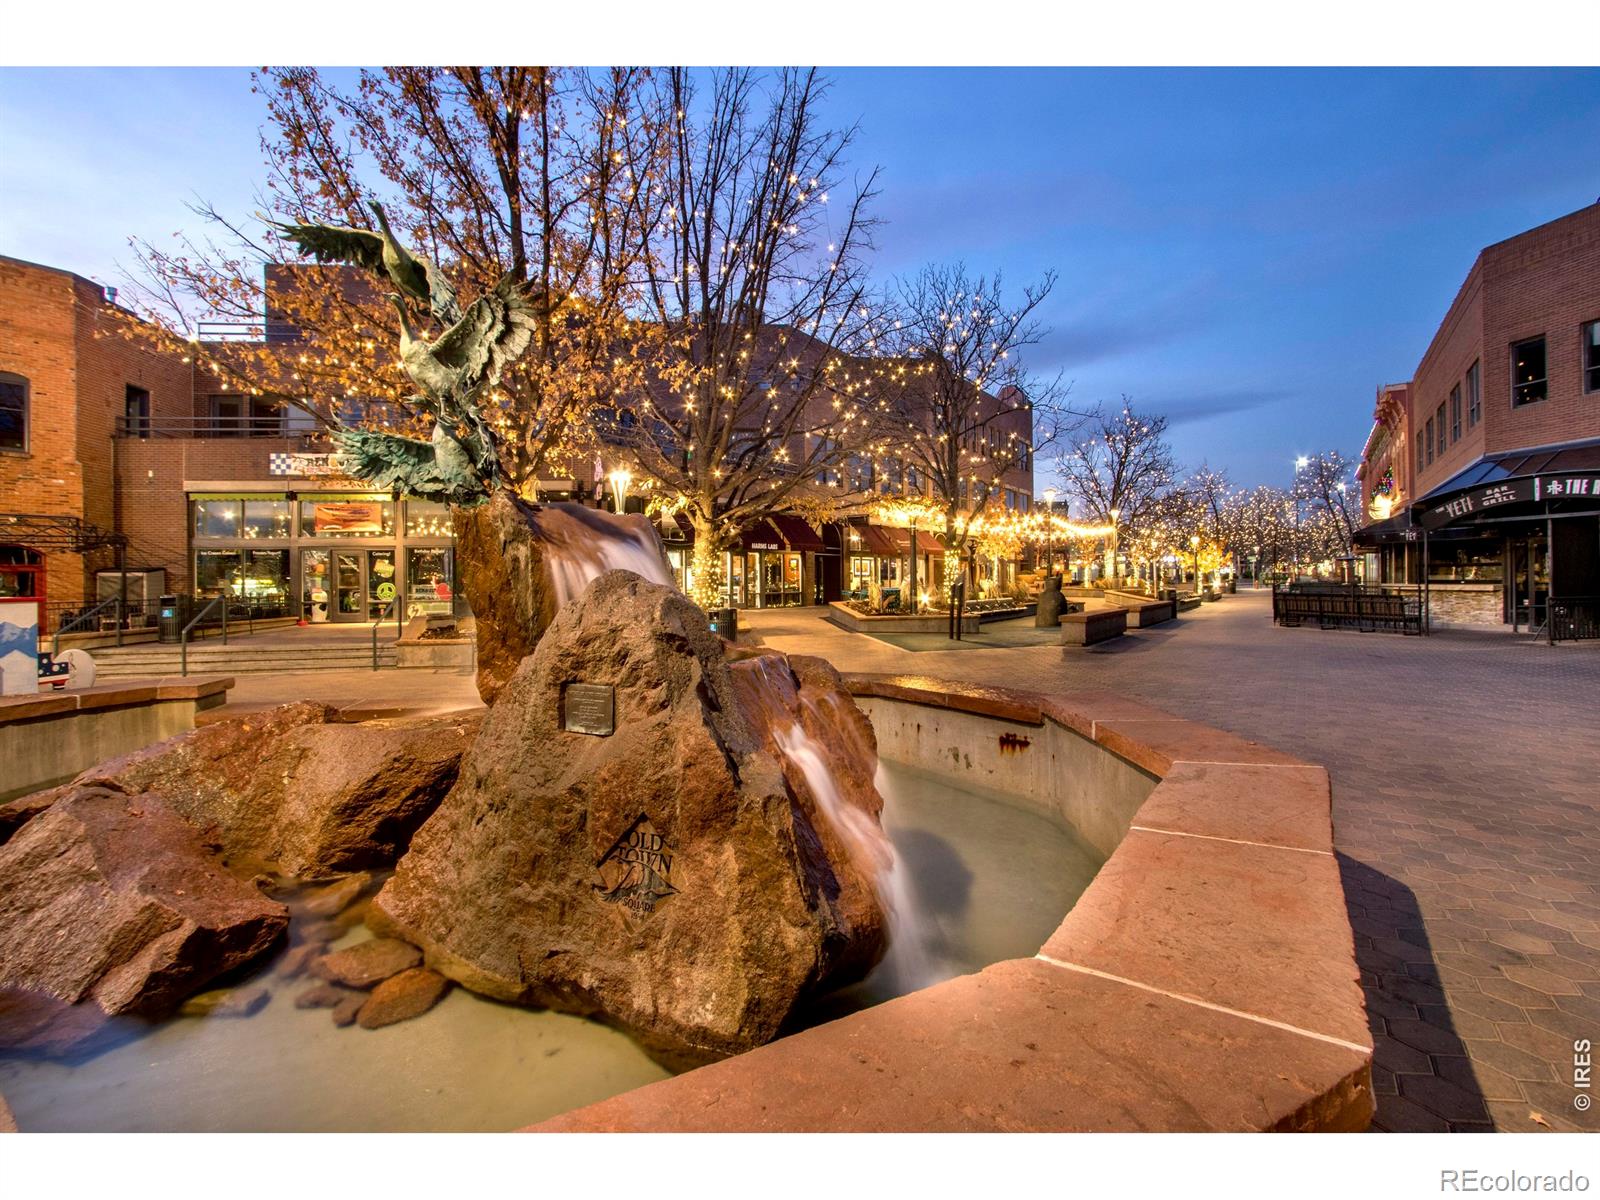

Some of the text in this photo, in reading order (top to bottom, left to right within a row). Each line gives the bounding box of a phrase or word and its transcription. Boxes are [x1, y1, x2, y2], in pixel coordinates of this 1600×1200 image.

[1486, 486, 1508, 495] BAR
[1565, 479, 1589, 494] THE
[1445, 495, 1473, 517] YETI
[1482, 495, 1516, 506] GRILL
[628, 831, 664, 852] OLD
[618, 846, 673, 874] TOWN
[622, 897, 656, 913] SQUARE
